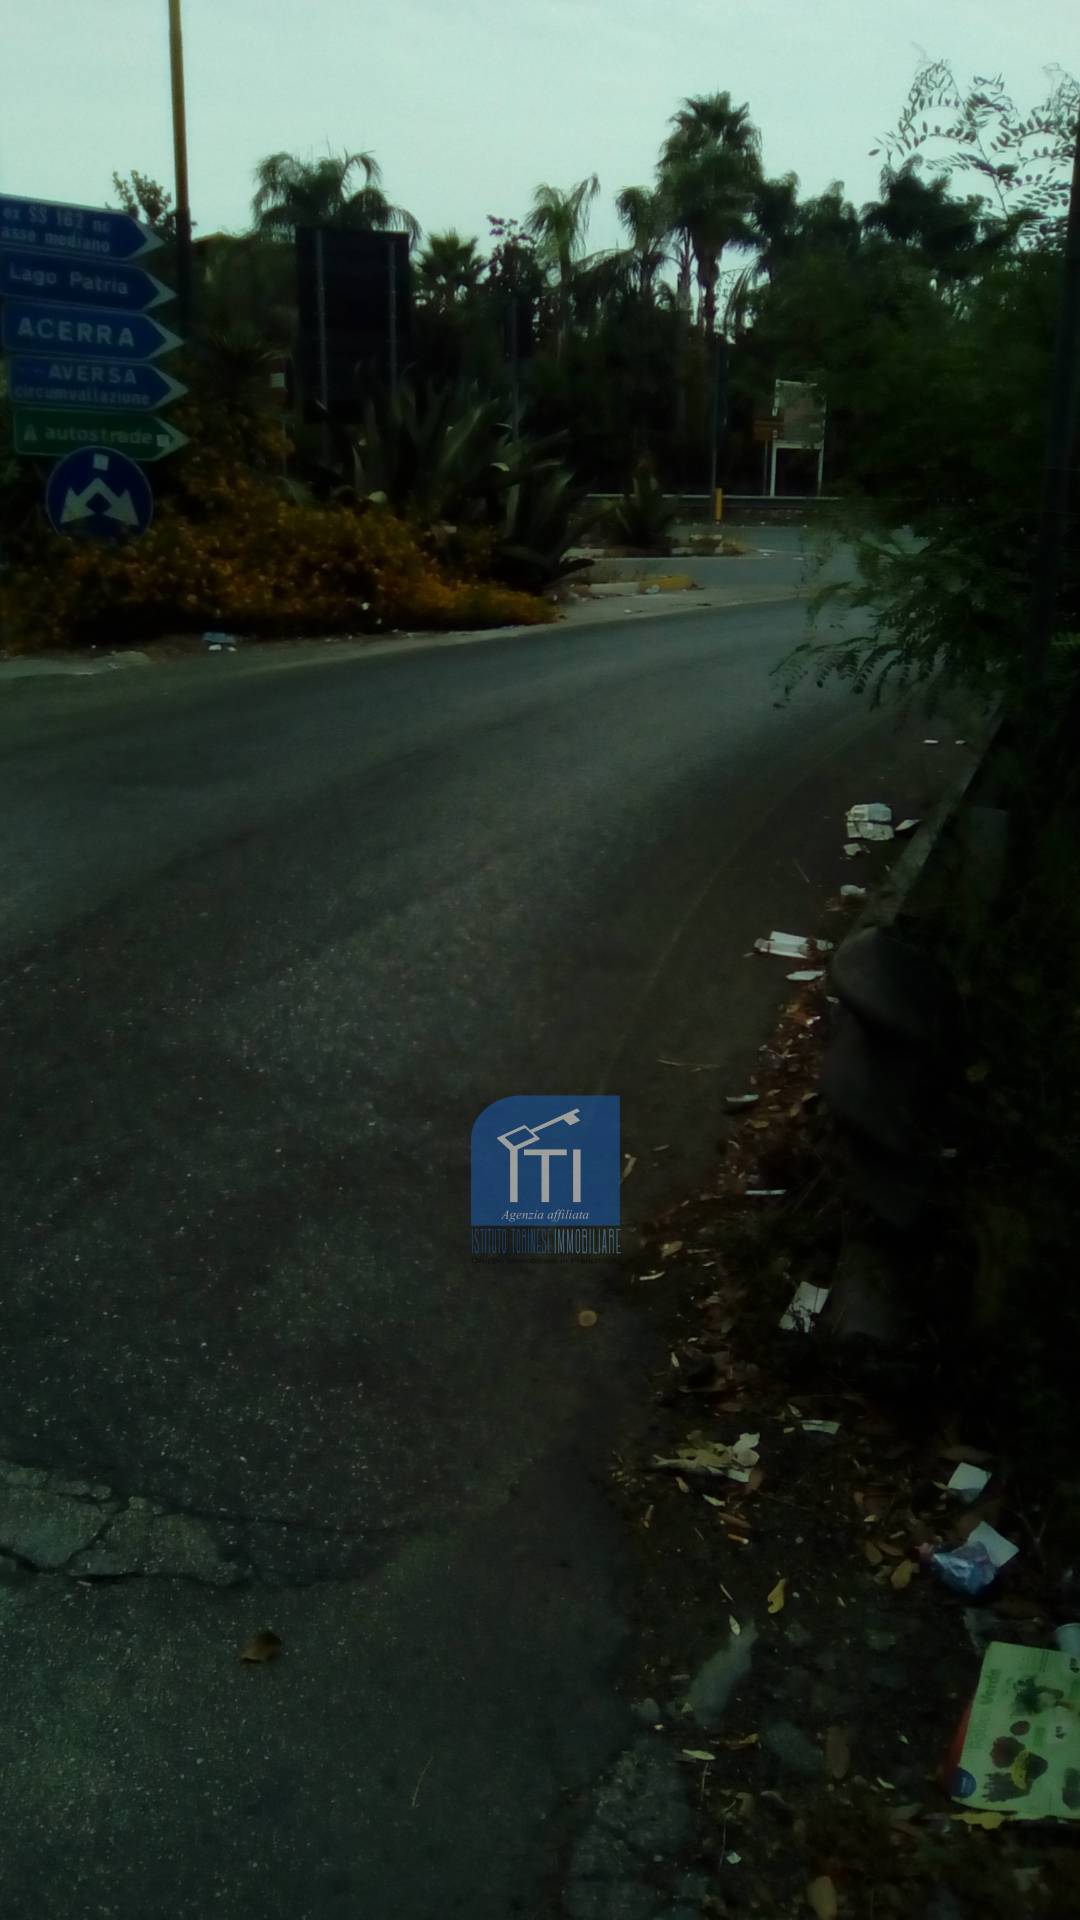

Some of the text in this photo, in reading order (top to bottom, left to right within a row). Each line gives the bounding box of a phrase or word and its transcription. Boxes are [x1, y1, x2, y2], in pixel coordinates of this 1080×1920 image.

[8, 261, 129, 296] Lago Patria
[17, 316, 136, 348] ACERRA
[48, 364, 138, 385] AVERSA
[44, 424, 153, 446] autostrade
